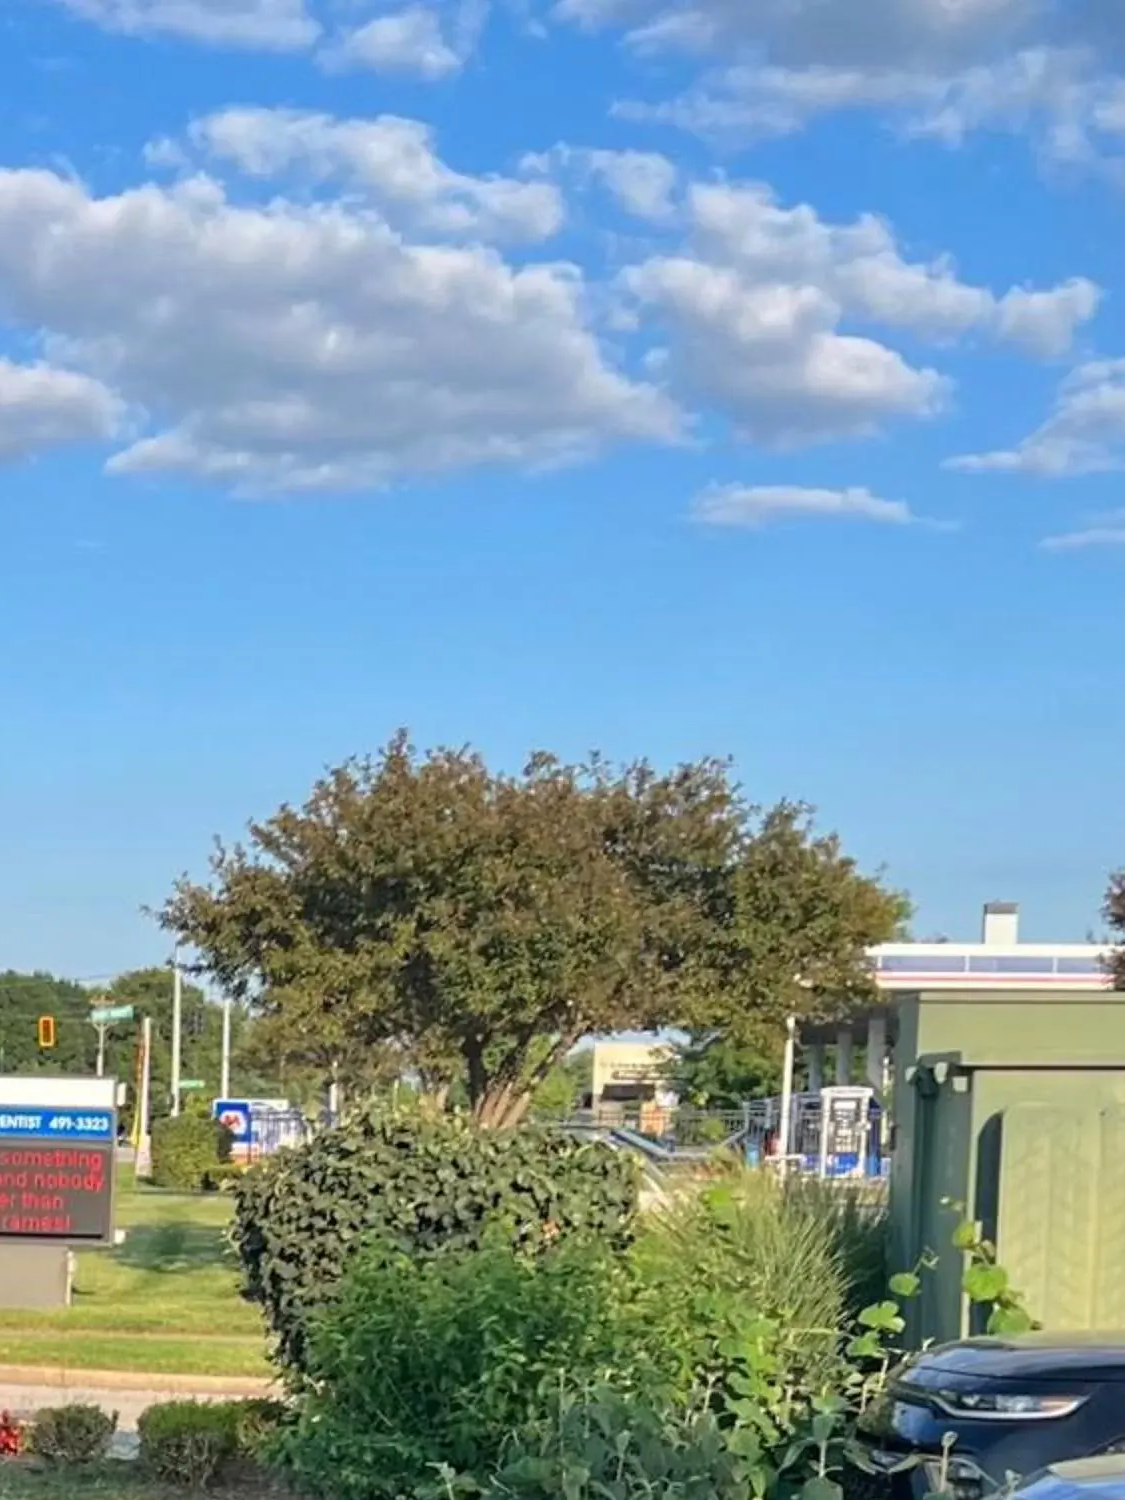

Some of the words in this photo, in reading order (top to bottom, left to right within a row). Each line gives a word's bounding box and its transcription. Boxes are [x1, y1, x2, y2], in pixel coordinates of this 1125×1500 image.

[48, 1115, 109, 1132] 491-3323
[34, 1170, 105, 1193] nobody
[22, 1191, 64, 1210] than
